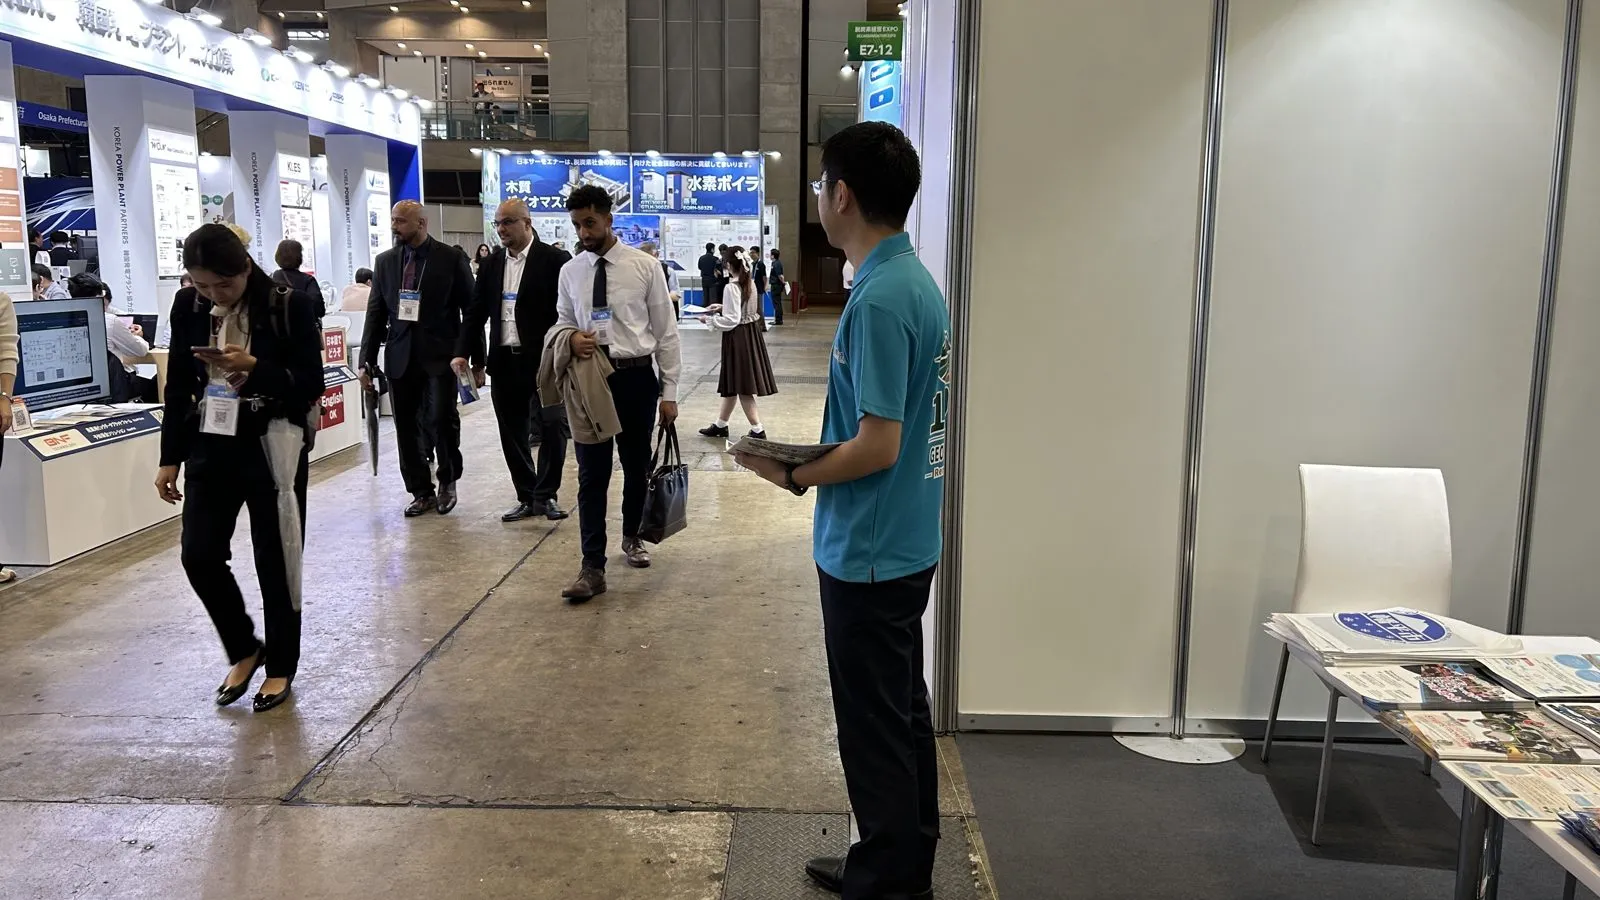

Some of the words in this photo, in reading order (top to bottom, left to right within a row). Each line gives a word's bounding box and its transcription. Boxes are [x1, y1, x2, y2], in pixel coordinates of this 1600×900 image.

[860, 44, 893, 56] E7-12
[38, 111, 57, 122] Osaka
[113, 126, 122, 153] KOREA
[115, 153, 124, 182] POWER
[252, 173, 260, 199] POWER
[505, 180, 532, 194] 木質
[687, 174, 759, 192] 水素ボイラ
[117, 182, 126, 208] PLANT
[254, 198, 262, 218] PLANT
[119, 209, 129, 246] PARTNERS
[326, 334, 342, 346] 日本語で
[328, 348, 341, 359] どうぞ
[321, 391, 343, 408] English
[329, 409, 338, 420] OK
